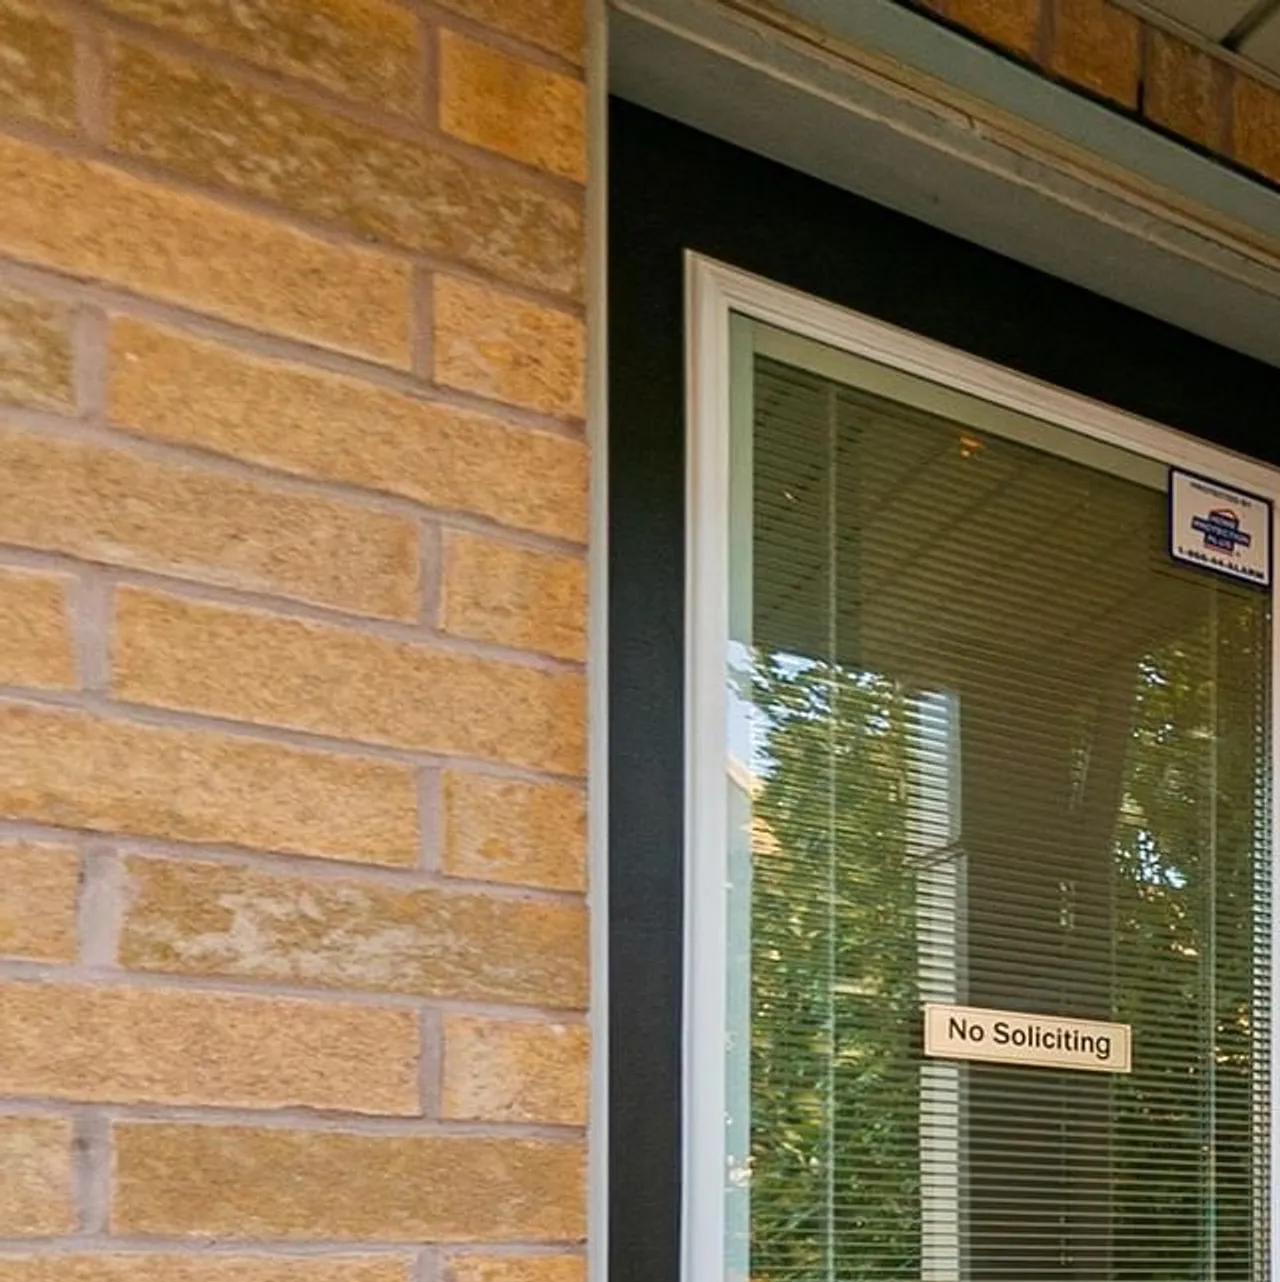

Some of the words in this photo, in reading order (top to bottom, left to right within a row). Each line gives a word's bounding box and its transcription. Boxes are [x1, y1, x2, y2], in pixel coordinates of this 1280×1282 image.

[1193, 521, 1249, 543] PROTECTION
[1208, 535, 1233, 549] PLUS
[948, 1017, 985, 1042] No
[993, 1021, 1111, 1060] Soliciting
